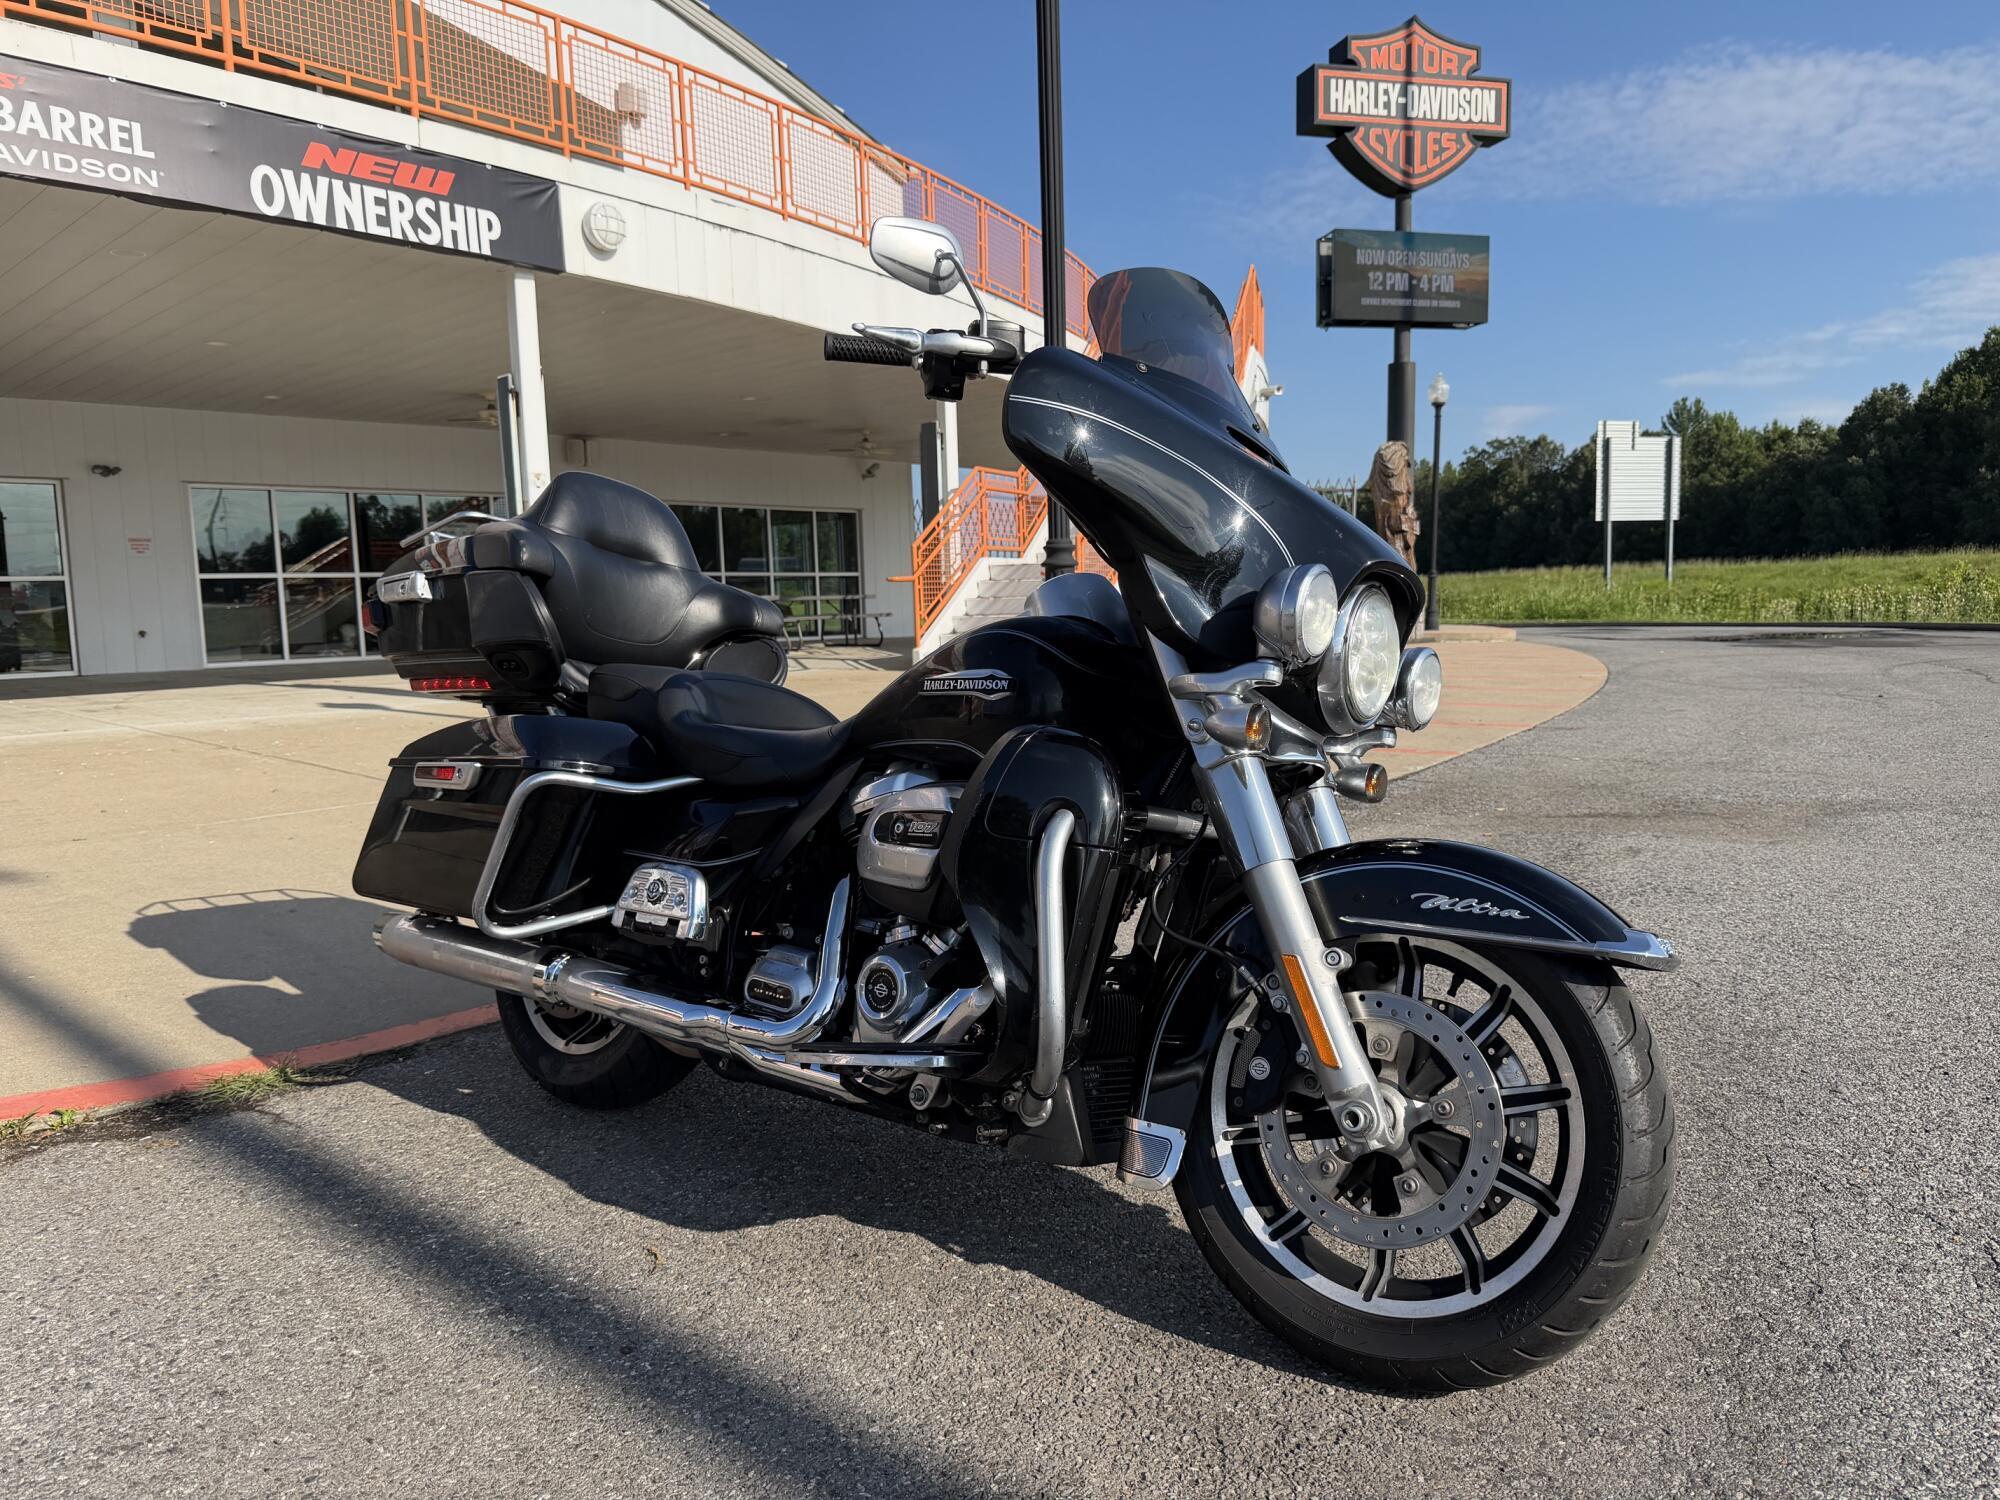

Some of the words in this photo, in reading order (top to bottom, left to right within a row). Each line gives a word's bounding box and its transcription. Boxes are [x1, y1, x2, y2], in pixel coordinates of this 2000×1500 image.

[1370, 33, 1459, 76] MOTOR
[1329, 78, 1496, 124] HARLEY-DAVIDSON
[301, 141, 456, 196] NEW
[1369, 127, 1458, 174] CYCLES
[250, 164, 502, 256] OWNERSHIP
[1356, 248, 1385, 266] NOW
[1387, 249, 1417, 268] OPEN
[1418, 251, 1471, 269] SUNDAYS
[1368, 271, 1384, 291] 12
[1386, 272, 1409, 292] PM
[1419, 274, 1429, 292] 4
[1432, 274, 1454, 293] PM
[923, 679, 1009, 691] HARLEY-DAVIDSON
[1410, 892, 1530, 920] Ultra
